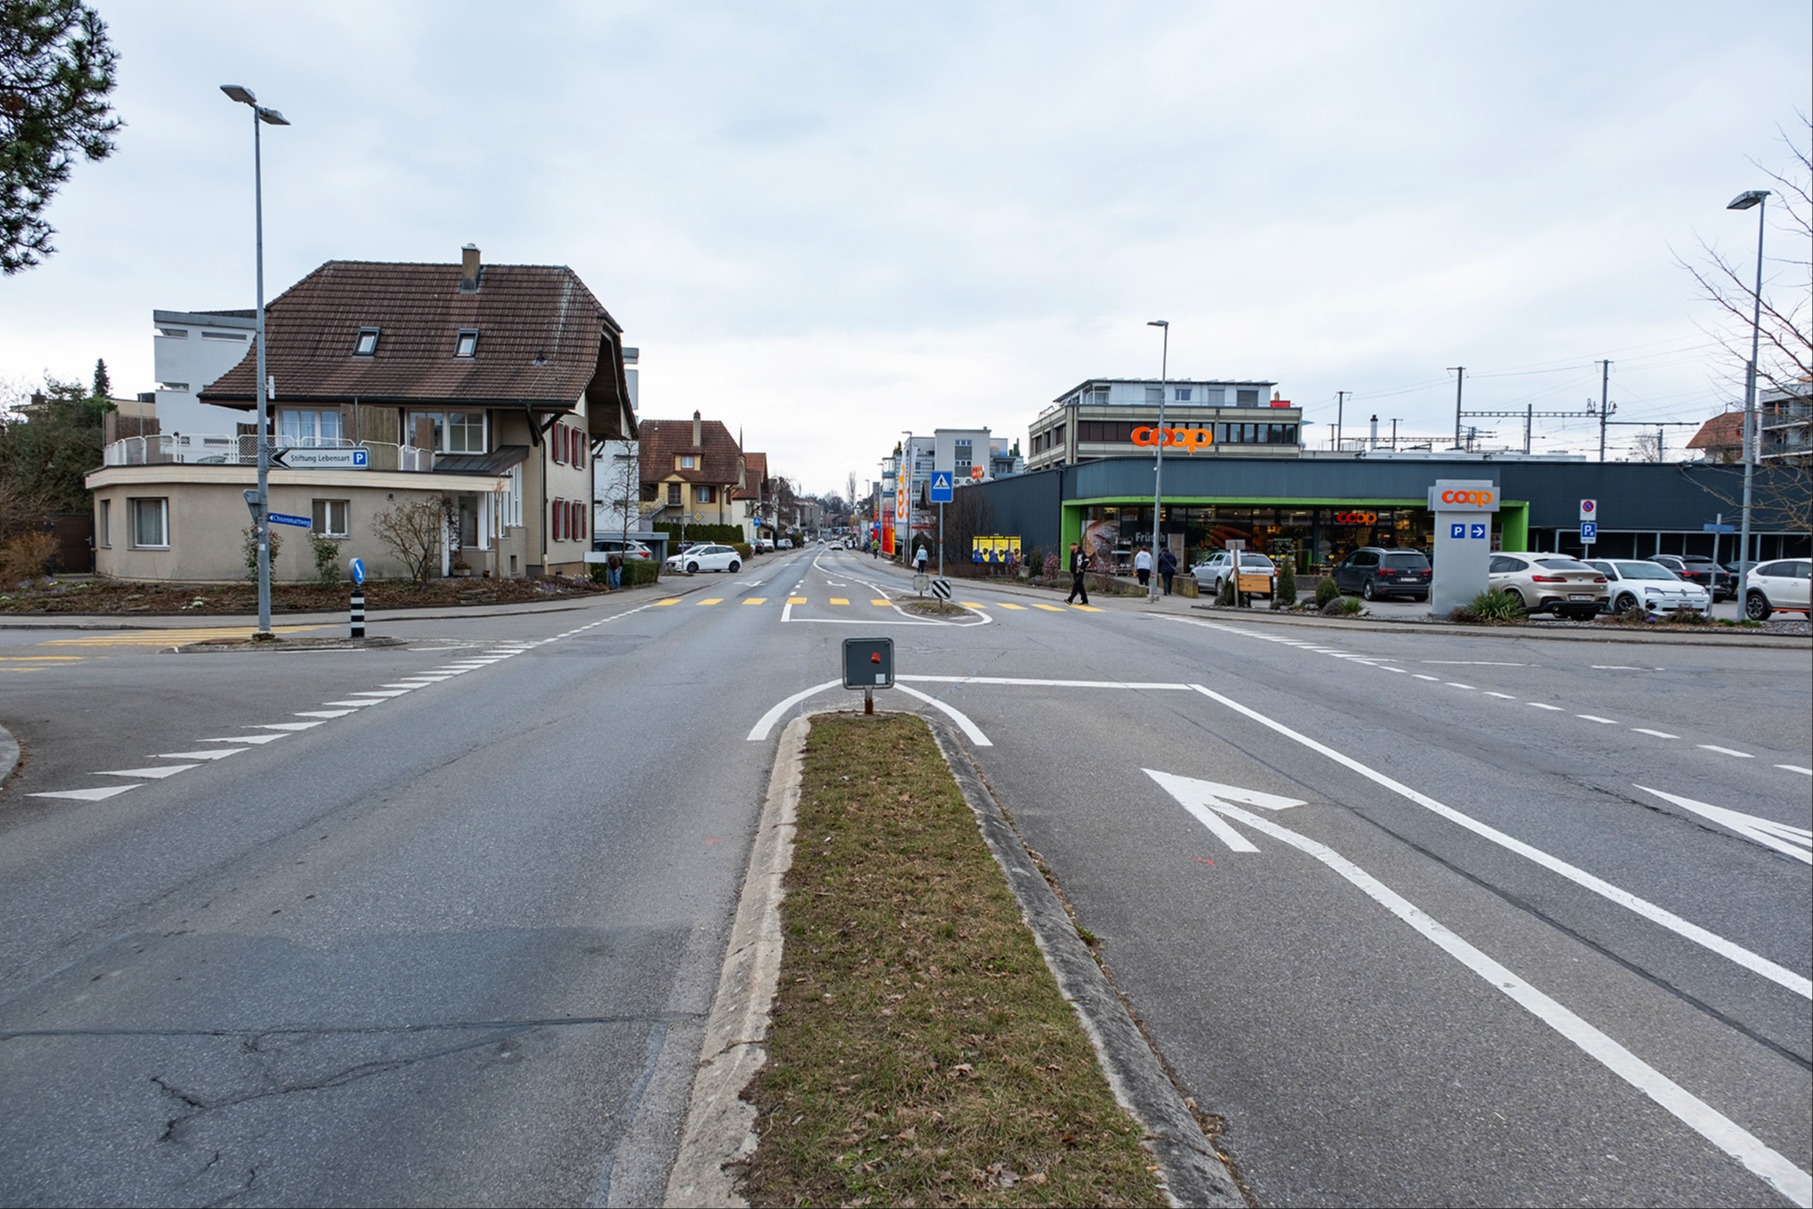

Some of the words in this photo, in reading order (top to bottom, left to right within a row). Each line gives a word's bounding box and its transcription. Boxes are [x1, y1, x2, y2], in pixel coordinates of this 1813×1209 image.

[1131, 426, 1213, 454] coop
[290, 454, 316, 463] Stiftung
[318, 454, 350, 462] Lebensart
[1441, 490, 1494, 508] coop
[1336, 511, 1378, 526] coop
